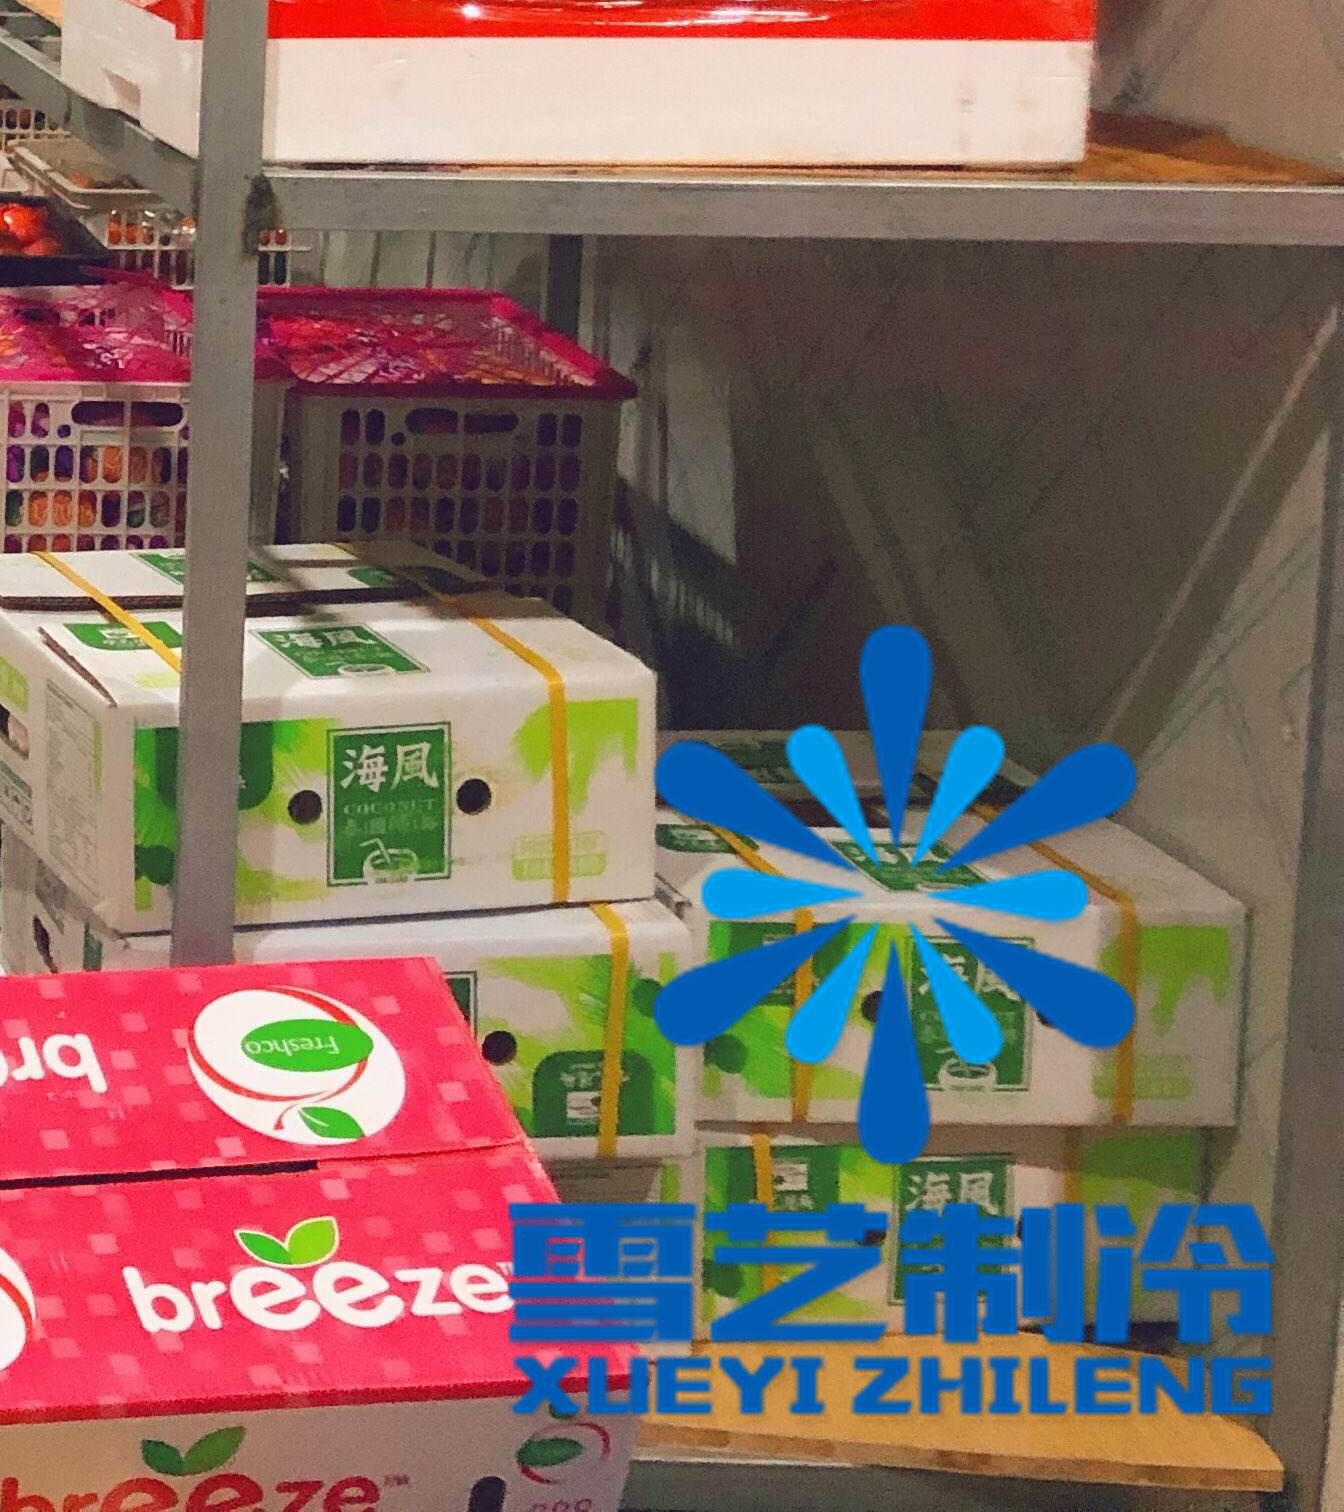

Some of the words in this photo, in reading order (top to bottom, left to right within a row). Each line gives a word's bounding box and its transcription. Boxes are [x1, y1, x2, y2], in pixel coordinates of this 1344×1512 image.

[340, 741, 440, 792] 海風
[242, 1034, 339, 1056] Freshco
[122, 1261, 516, 1334] breeze
